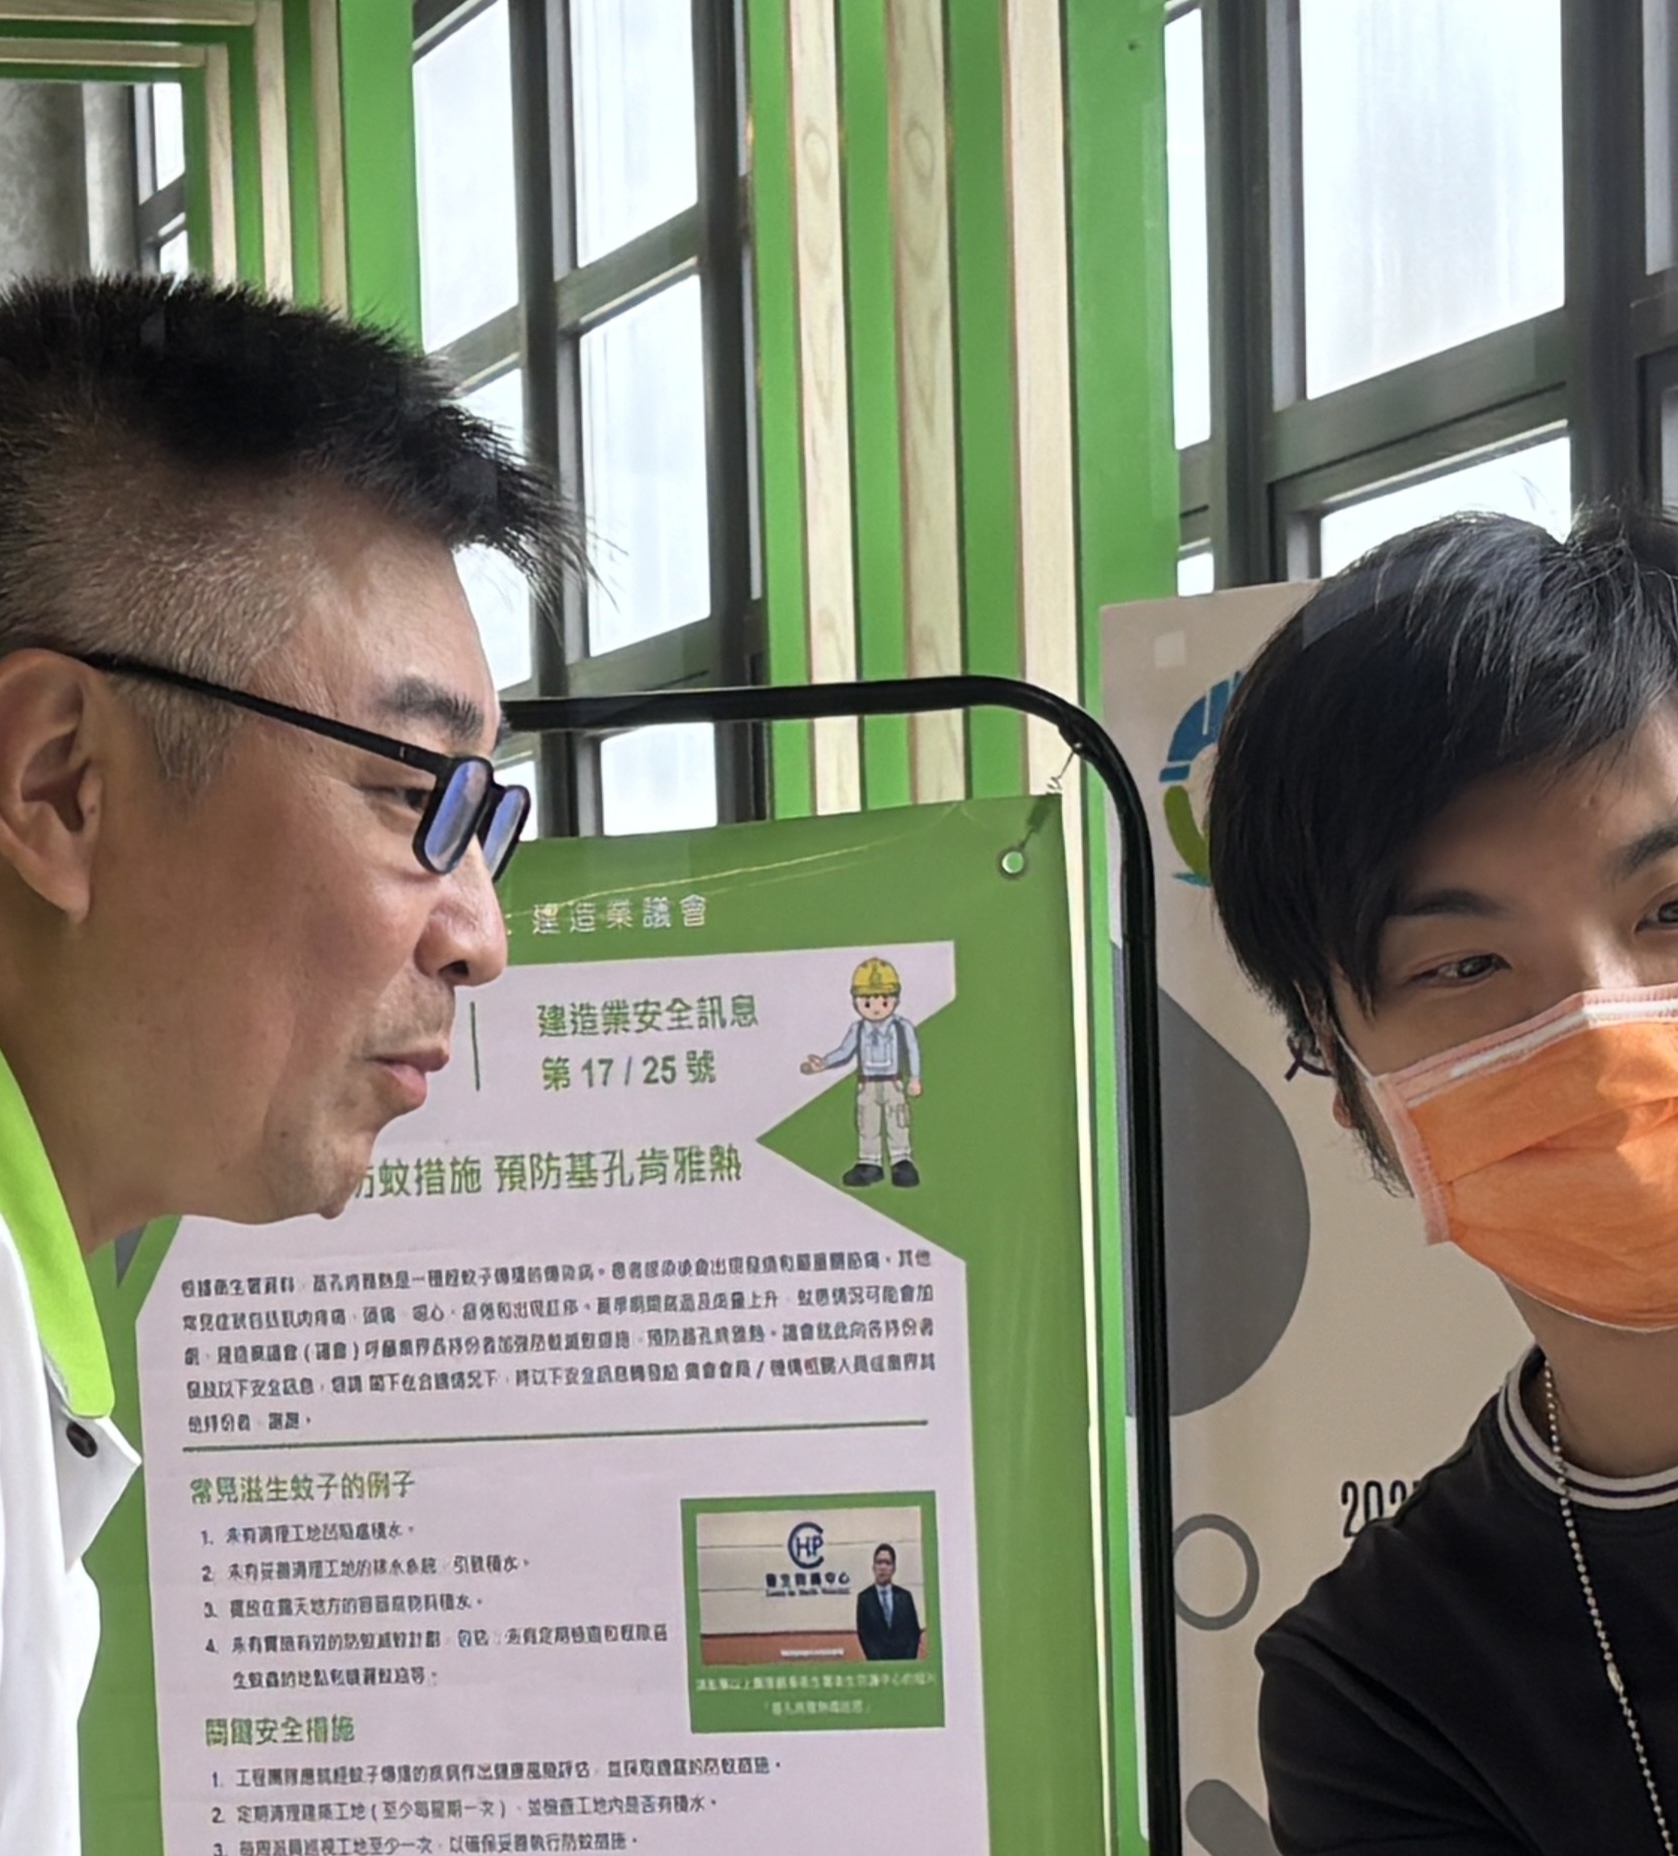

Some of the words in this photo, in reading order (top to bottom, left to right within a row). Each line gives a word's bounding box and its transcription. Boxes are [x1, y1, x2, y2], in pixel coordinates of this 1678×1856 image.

[532, 894, 707, 935] 建造業議會
[537, 994, 758, 1038] 建造業安全訊息
[542, 1055, 571, 1091] 第
[582, 1057, 613, 1088] 17
[642, 1054, 677, 1085] 25
[686, 1050, 716, 1084] 號
[494, 1142, 742, 1194] 預防基孔肯雅熱
[190, 1470, 415, 1504] 常見滋生蚊子的例子
[1341, 1479, 1421, 1538] 20
